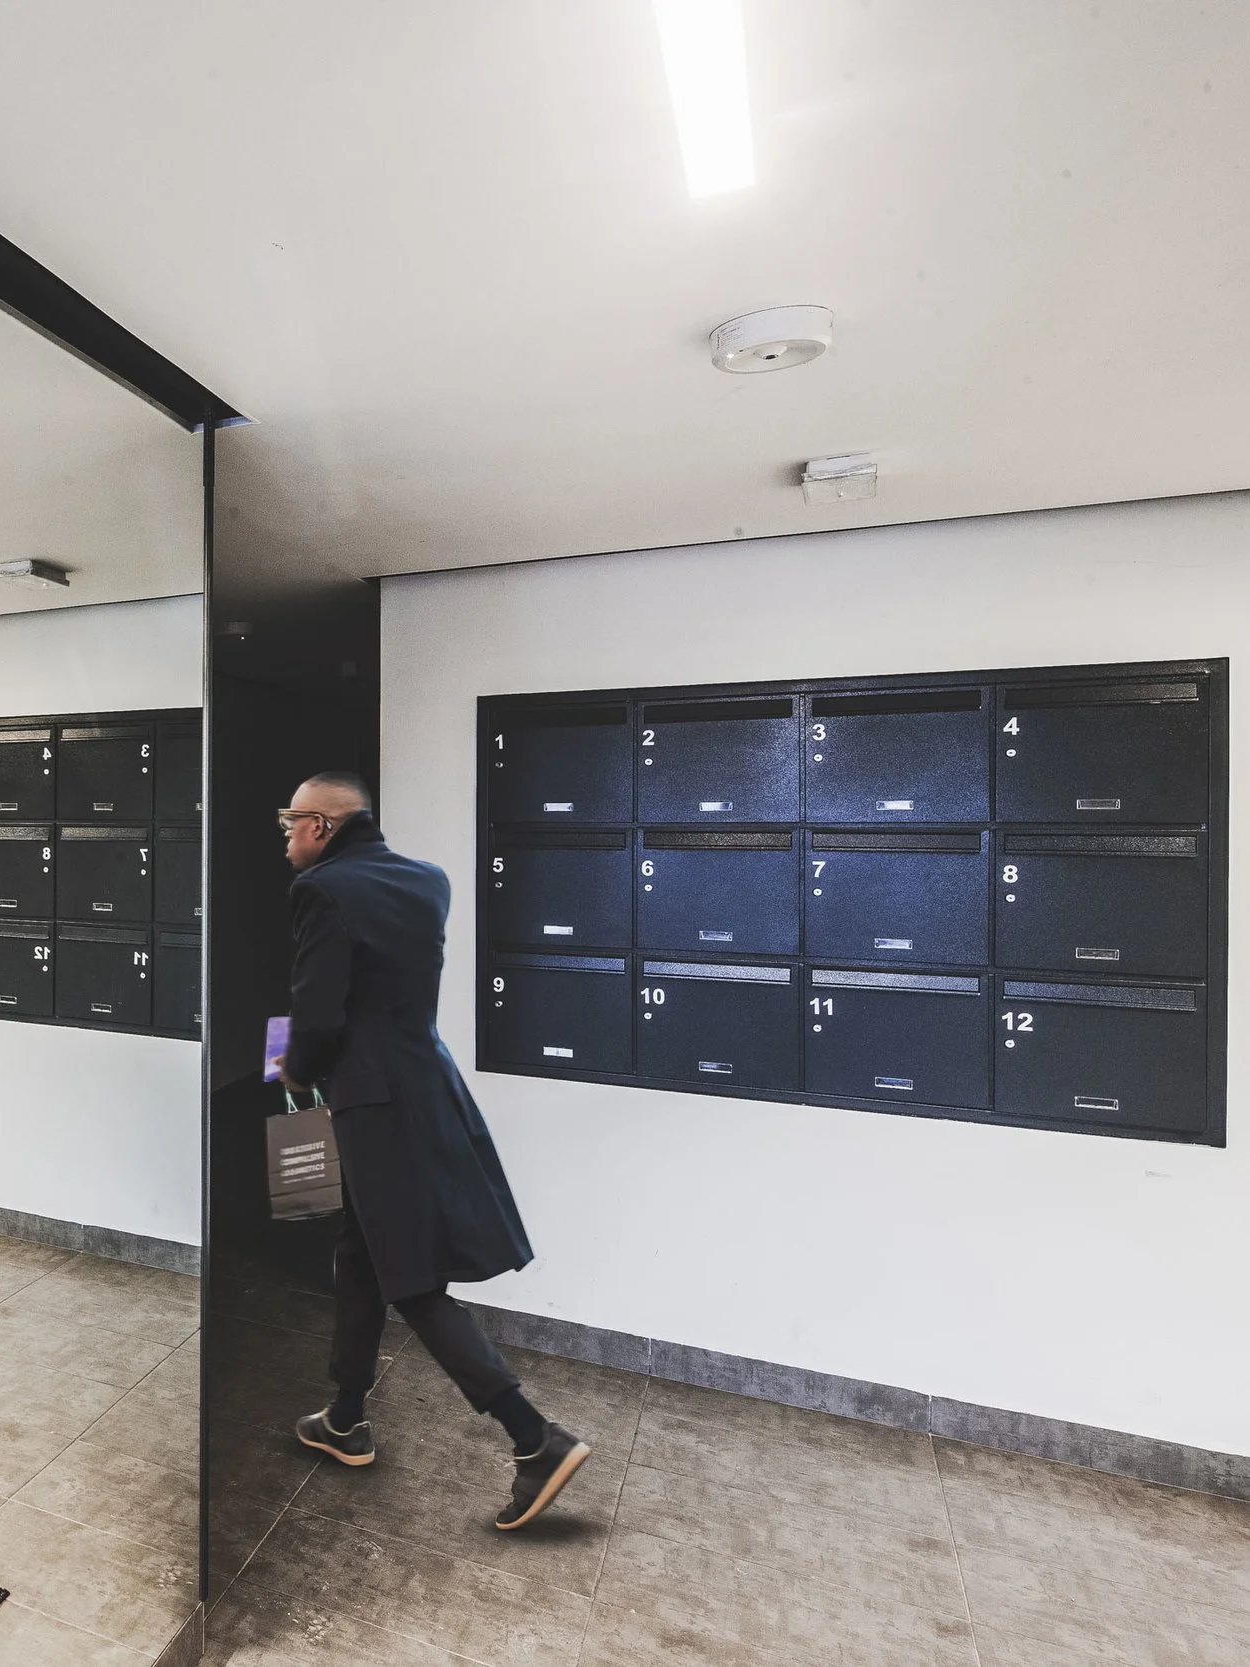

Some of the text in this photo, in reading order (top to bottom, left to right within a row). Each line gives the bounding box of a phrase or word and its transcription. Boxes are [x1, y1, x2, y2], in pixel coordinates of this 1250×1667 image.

[811, 723, 827, 742] 3
[1002, 716, 1020, 736] 4
[494, 734, 504, 750] 1
[642, 729, 655, 746] 2
[492, 857, 504, 873] 5
[641, 860, 654, 877] 6
[811, 860, 826, 878] 7
[1002, 864, 1019, 884] 8
[493, 976, 505, 993] 9
[640, 987, 666, 1005] 10
[809, 997, 833, 1016] 11
[1001, 1011, 1034, 1032] 12
[280, 1162, 325, 1177] COSTICS
